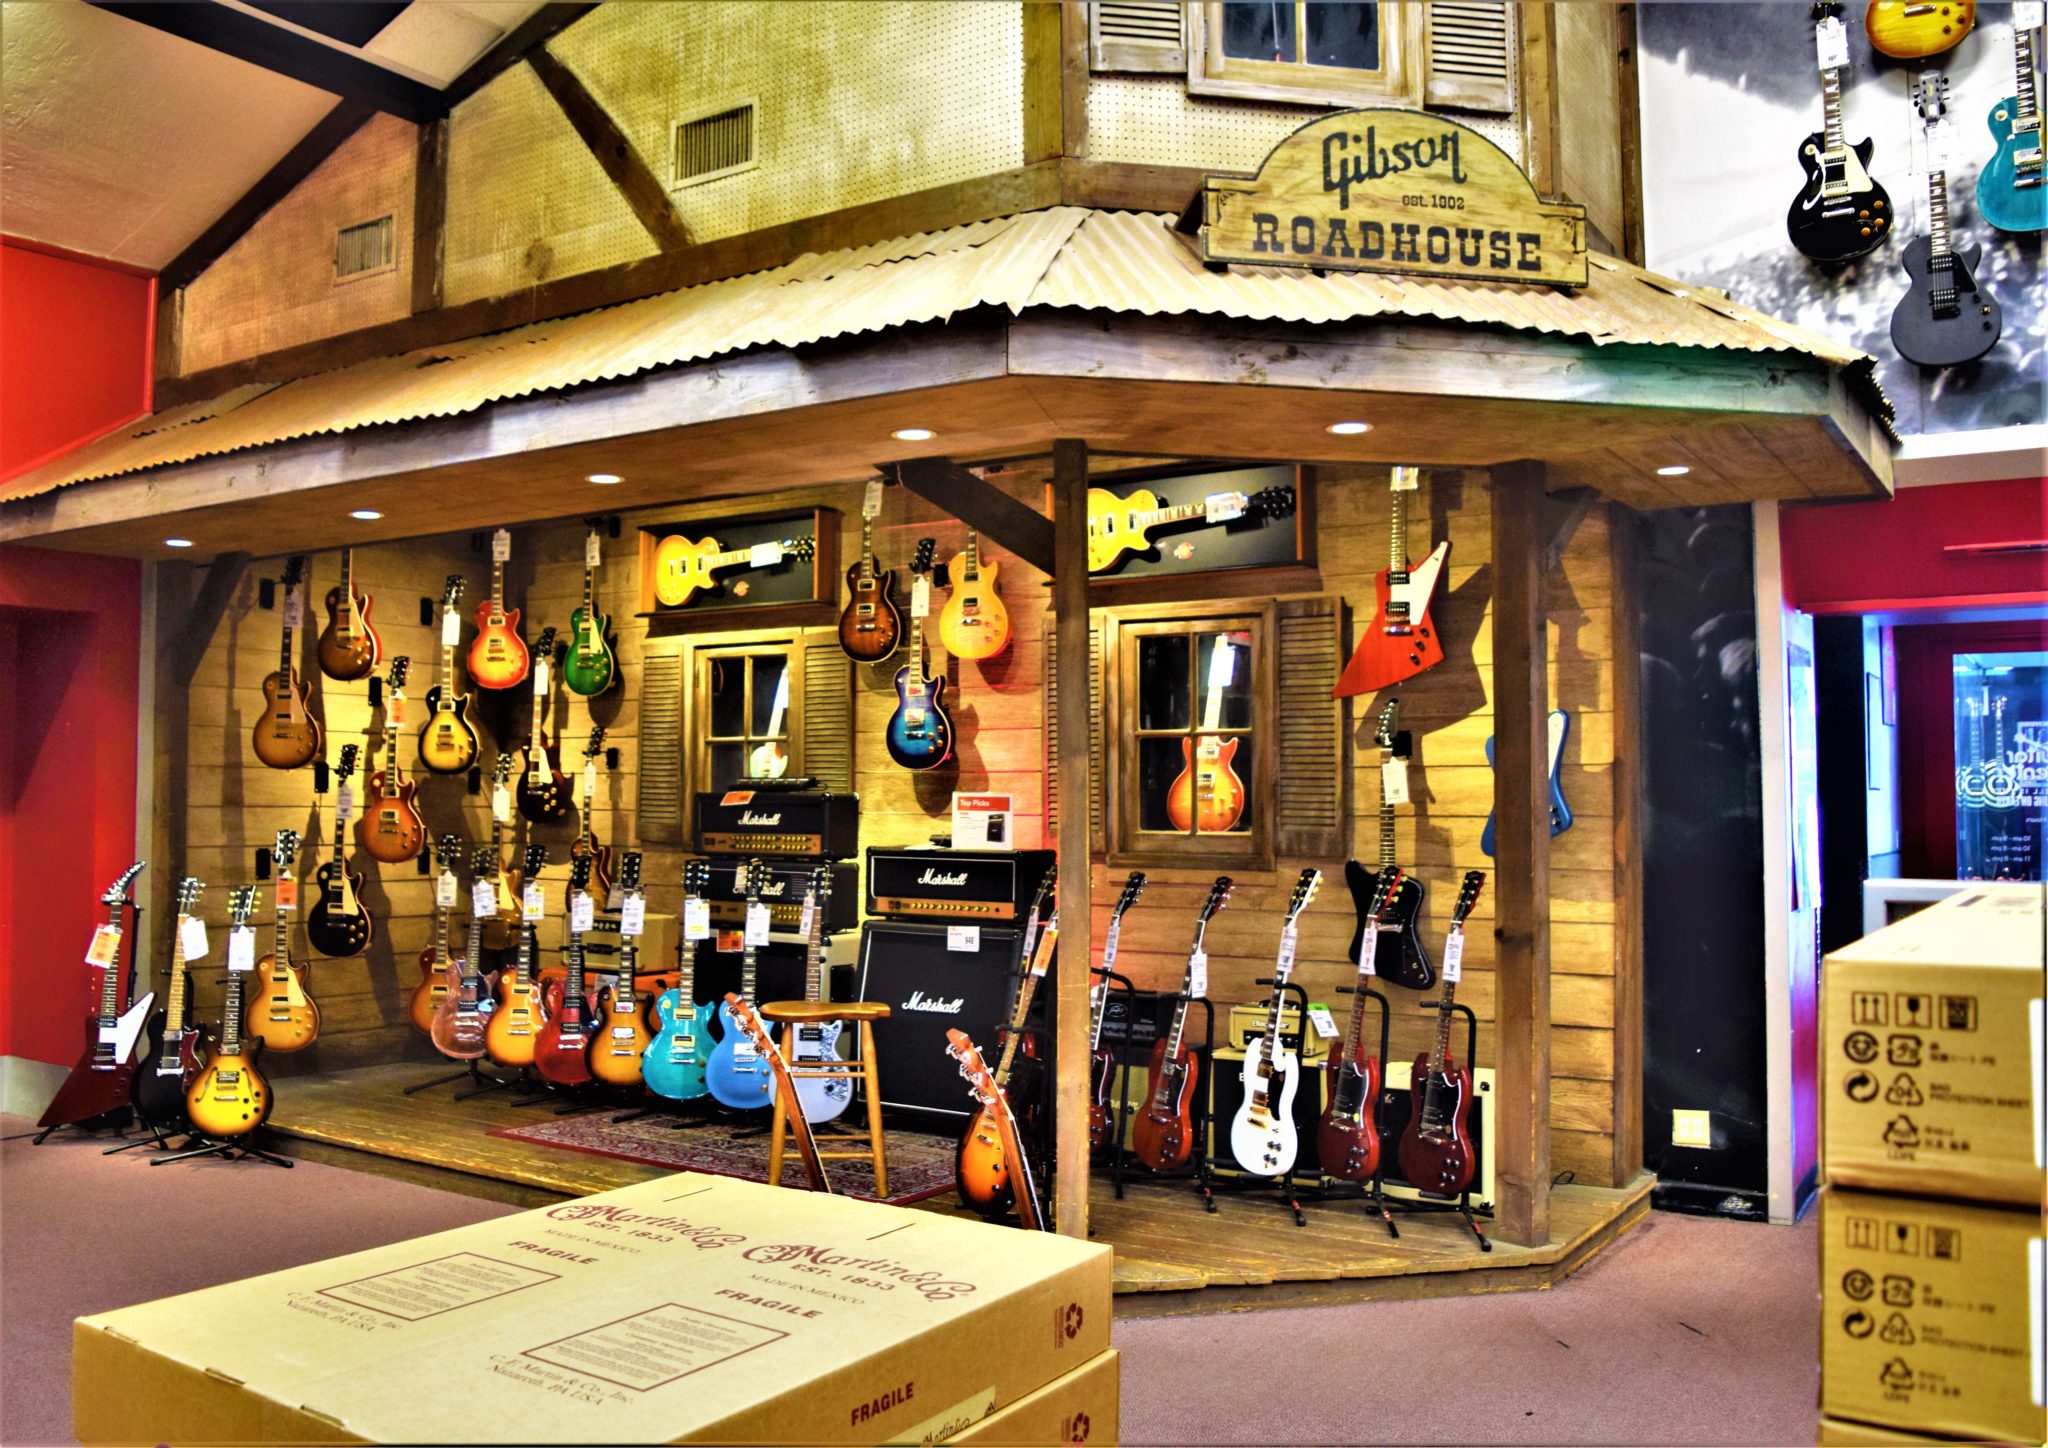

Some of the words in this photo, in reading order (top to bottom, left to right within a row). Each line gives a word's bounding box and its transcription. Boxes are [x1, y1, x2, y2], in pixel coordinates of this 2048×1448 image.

[1322, 125, 1467, 210] Gibson
[1402, 194, 1428, 209] est.
[1252, 212, 1542, 272] ROADHOUSE
[960, 799, 971, 808] Top
[972, 799, 990, 807] Picks
[738, 810, 781, 826] Marshall
[917, 868, 968, 886] Marshall
[902, 991, 964, 1014] Marshall
[585, 1220, 622, 1232] EST.
[627, 1229, 675, 1243] 1833
[507, 1240, 599, 1265] FRAGILE
[746, 1274, 790, 1287] MADE
[807, 1287, 865, 1305] MEXICO
[790, 1263, 832, 1277] EST.
[841, 1275, 896, 1292] 1833
[714, 1288, 823, 1320] FRAGILE
[851, 1382, 914, 1426] FRAGILE
